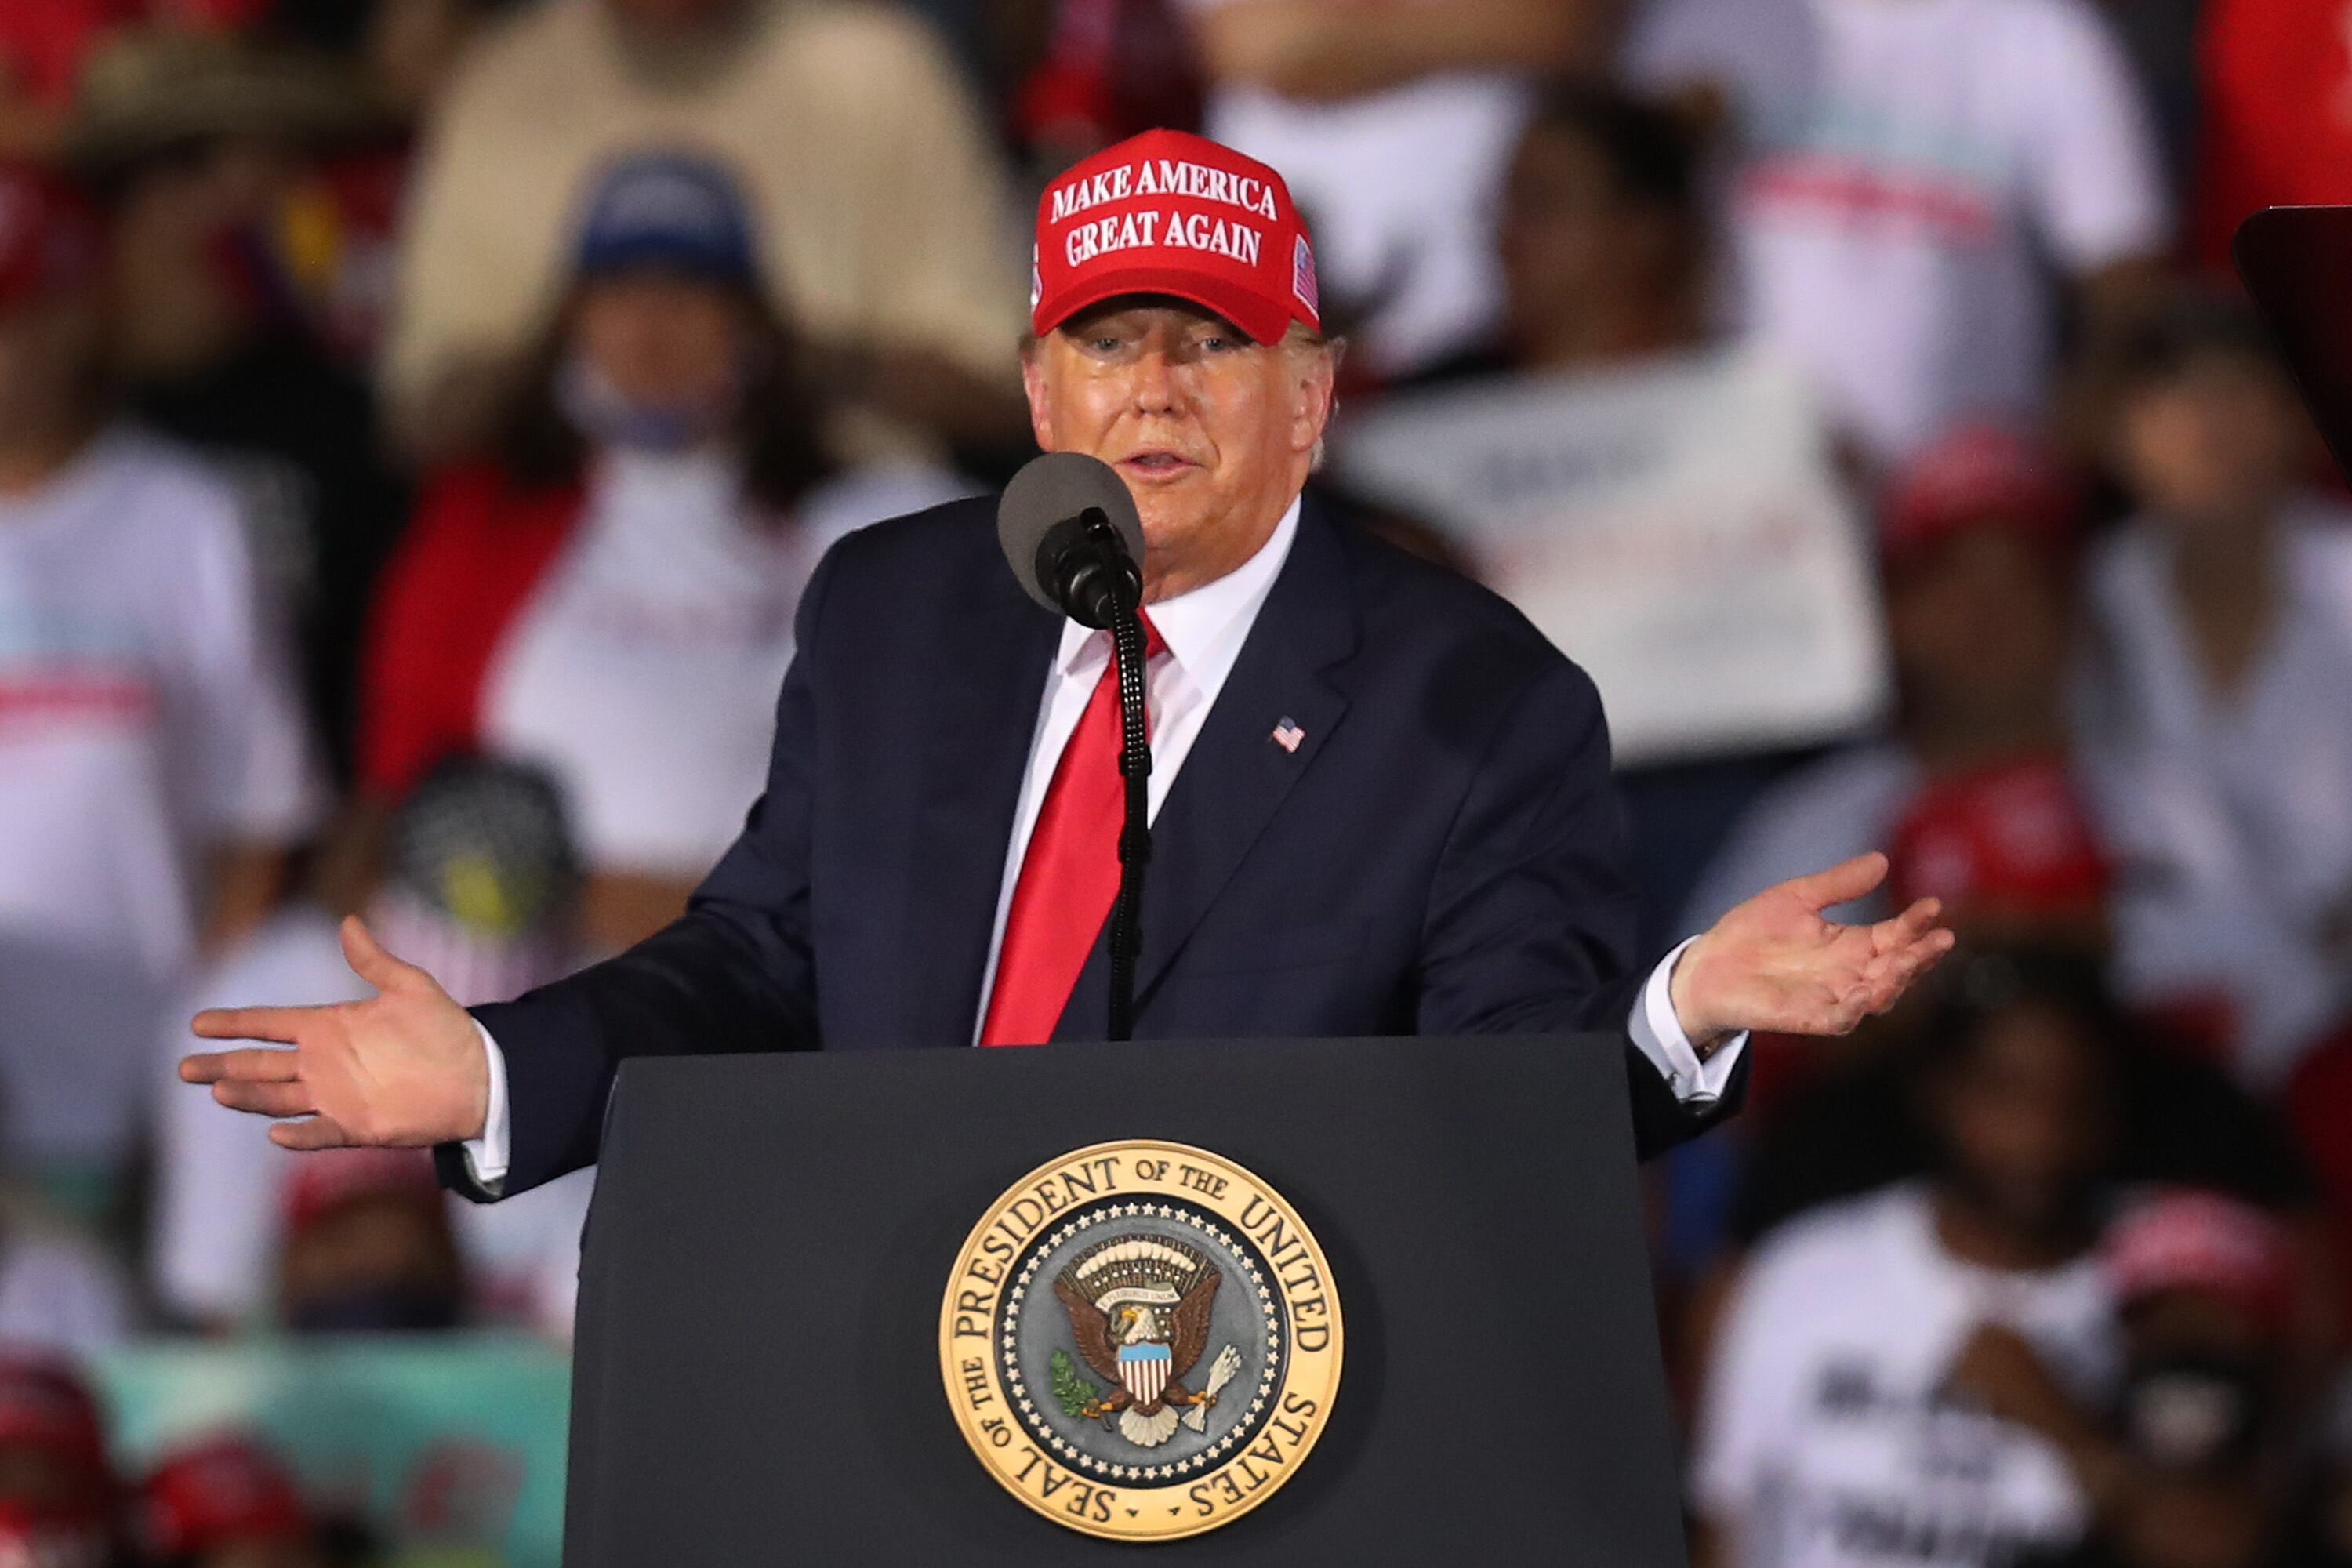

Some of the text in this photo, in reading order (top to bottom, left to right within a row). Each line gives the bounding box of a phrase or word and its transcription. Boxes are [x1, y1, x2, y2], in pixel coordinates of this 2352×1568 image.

[1050, 159, 1278, 224] MAKE AMERICA
[1065, 210, 1262, 267] GREAT AGAIN
[954, 1156, 1330, 1523] SEAL OF THE PRESIDENT OF THE UNITED STATES
